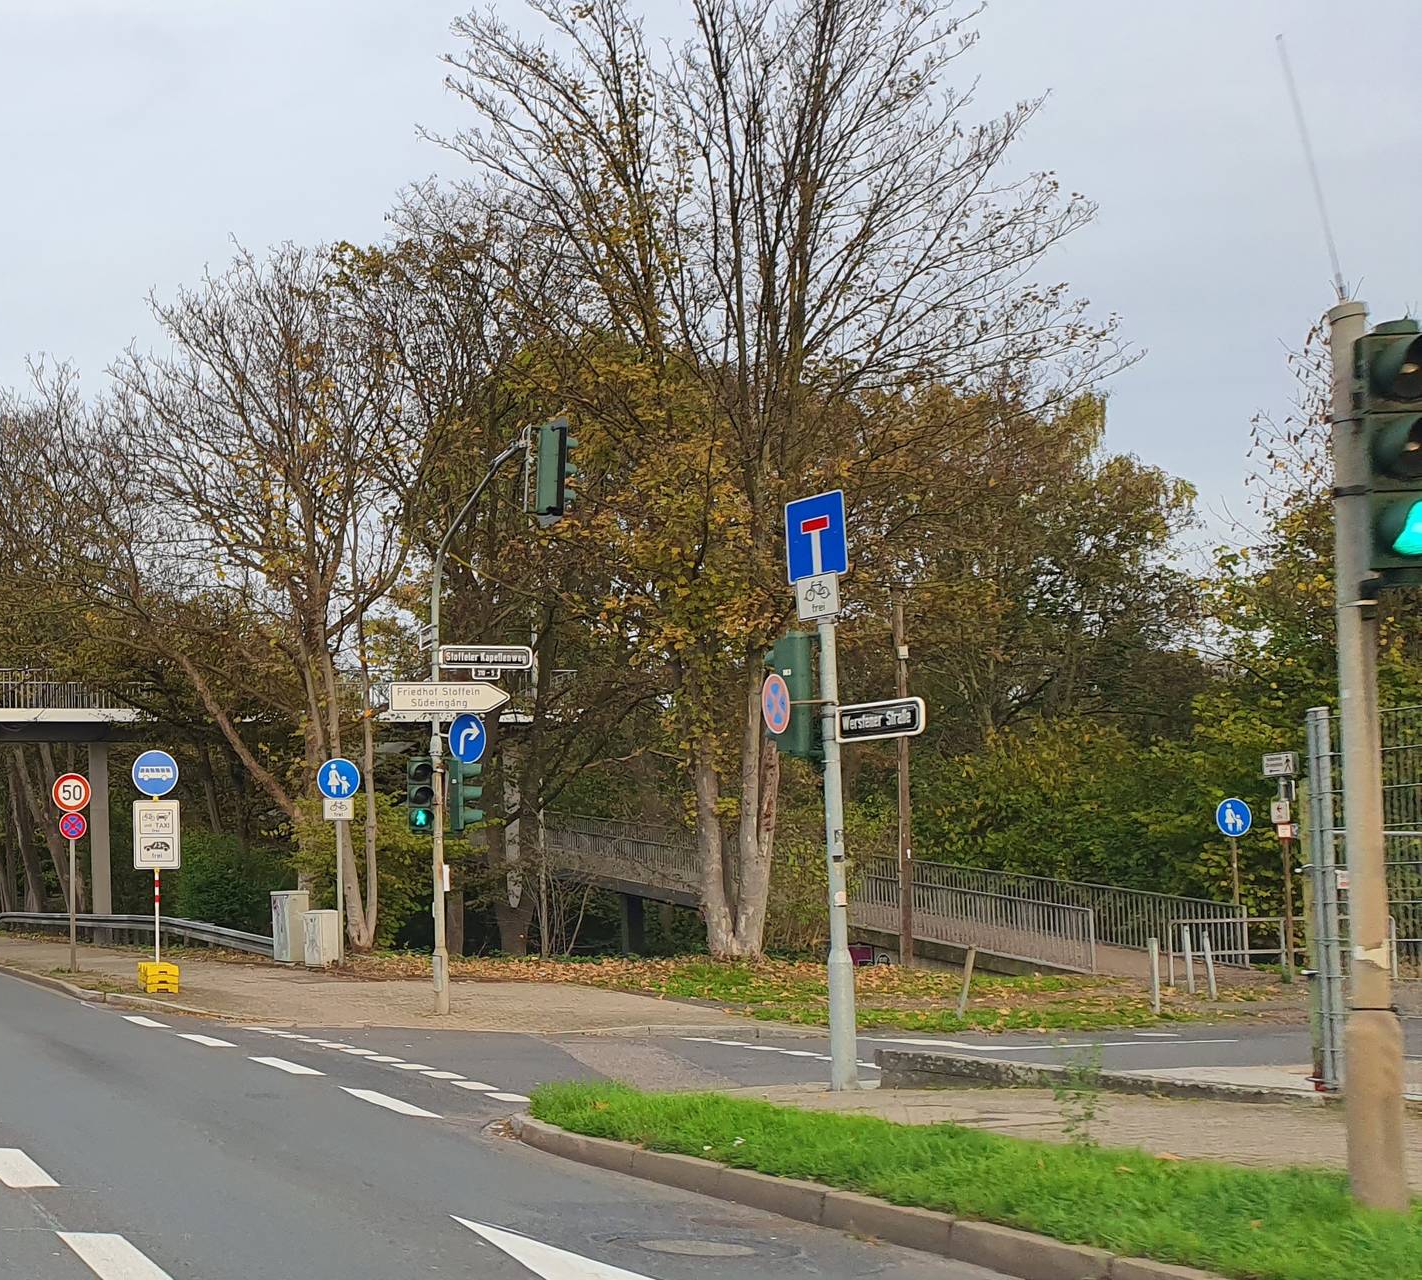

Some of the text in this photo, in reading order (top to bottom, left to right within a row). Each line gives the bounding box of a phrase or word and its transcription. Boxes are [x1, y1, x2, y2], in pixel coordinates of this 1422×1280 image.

[445, 651, 527, 665] Stoffeler Kapellenweg
[397, 687, 480, 696] Friedhof Stoffeln
[411, 698, 468, 708] Südeingang
[62, 784, 82, 801] 50
